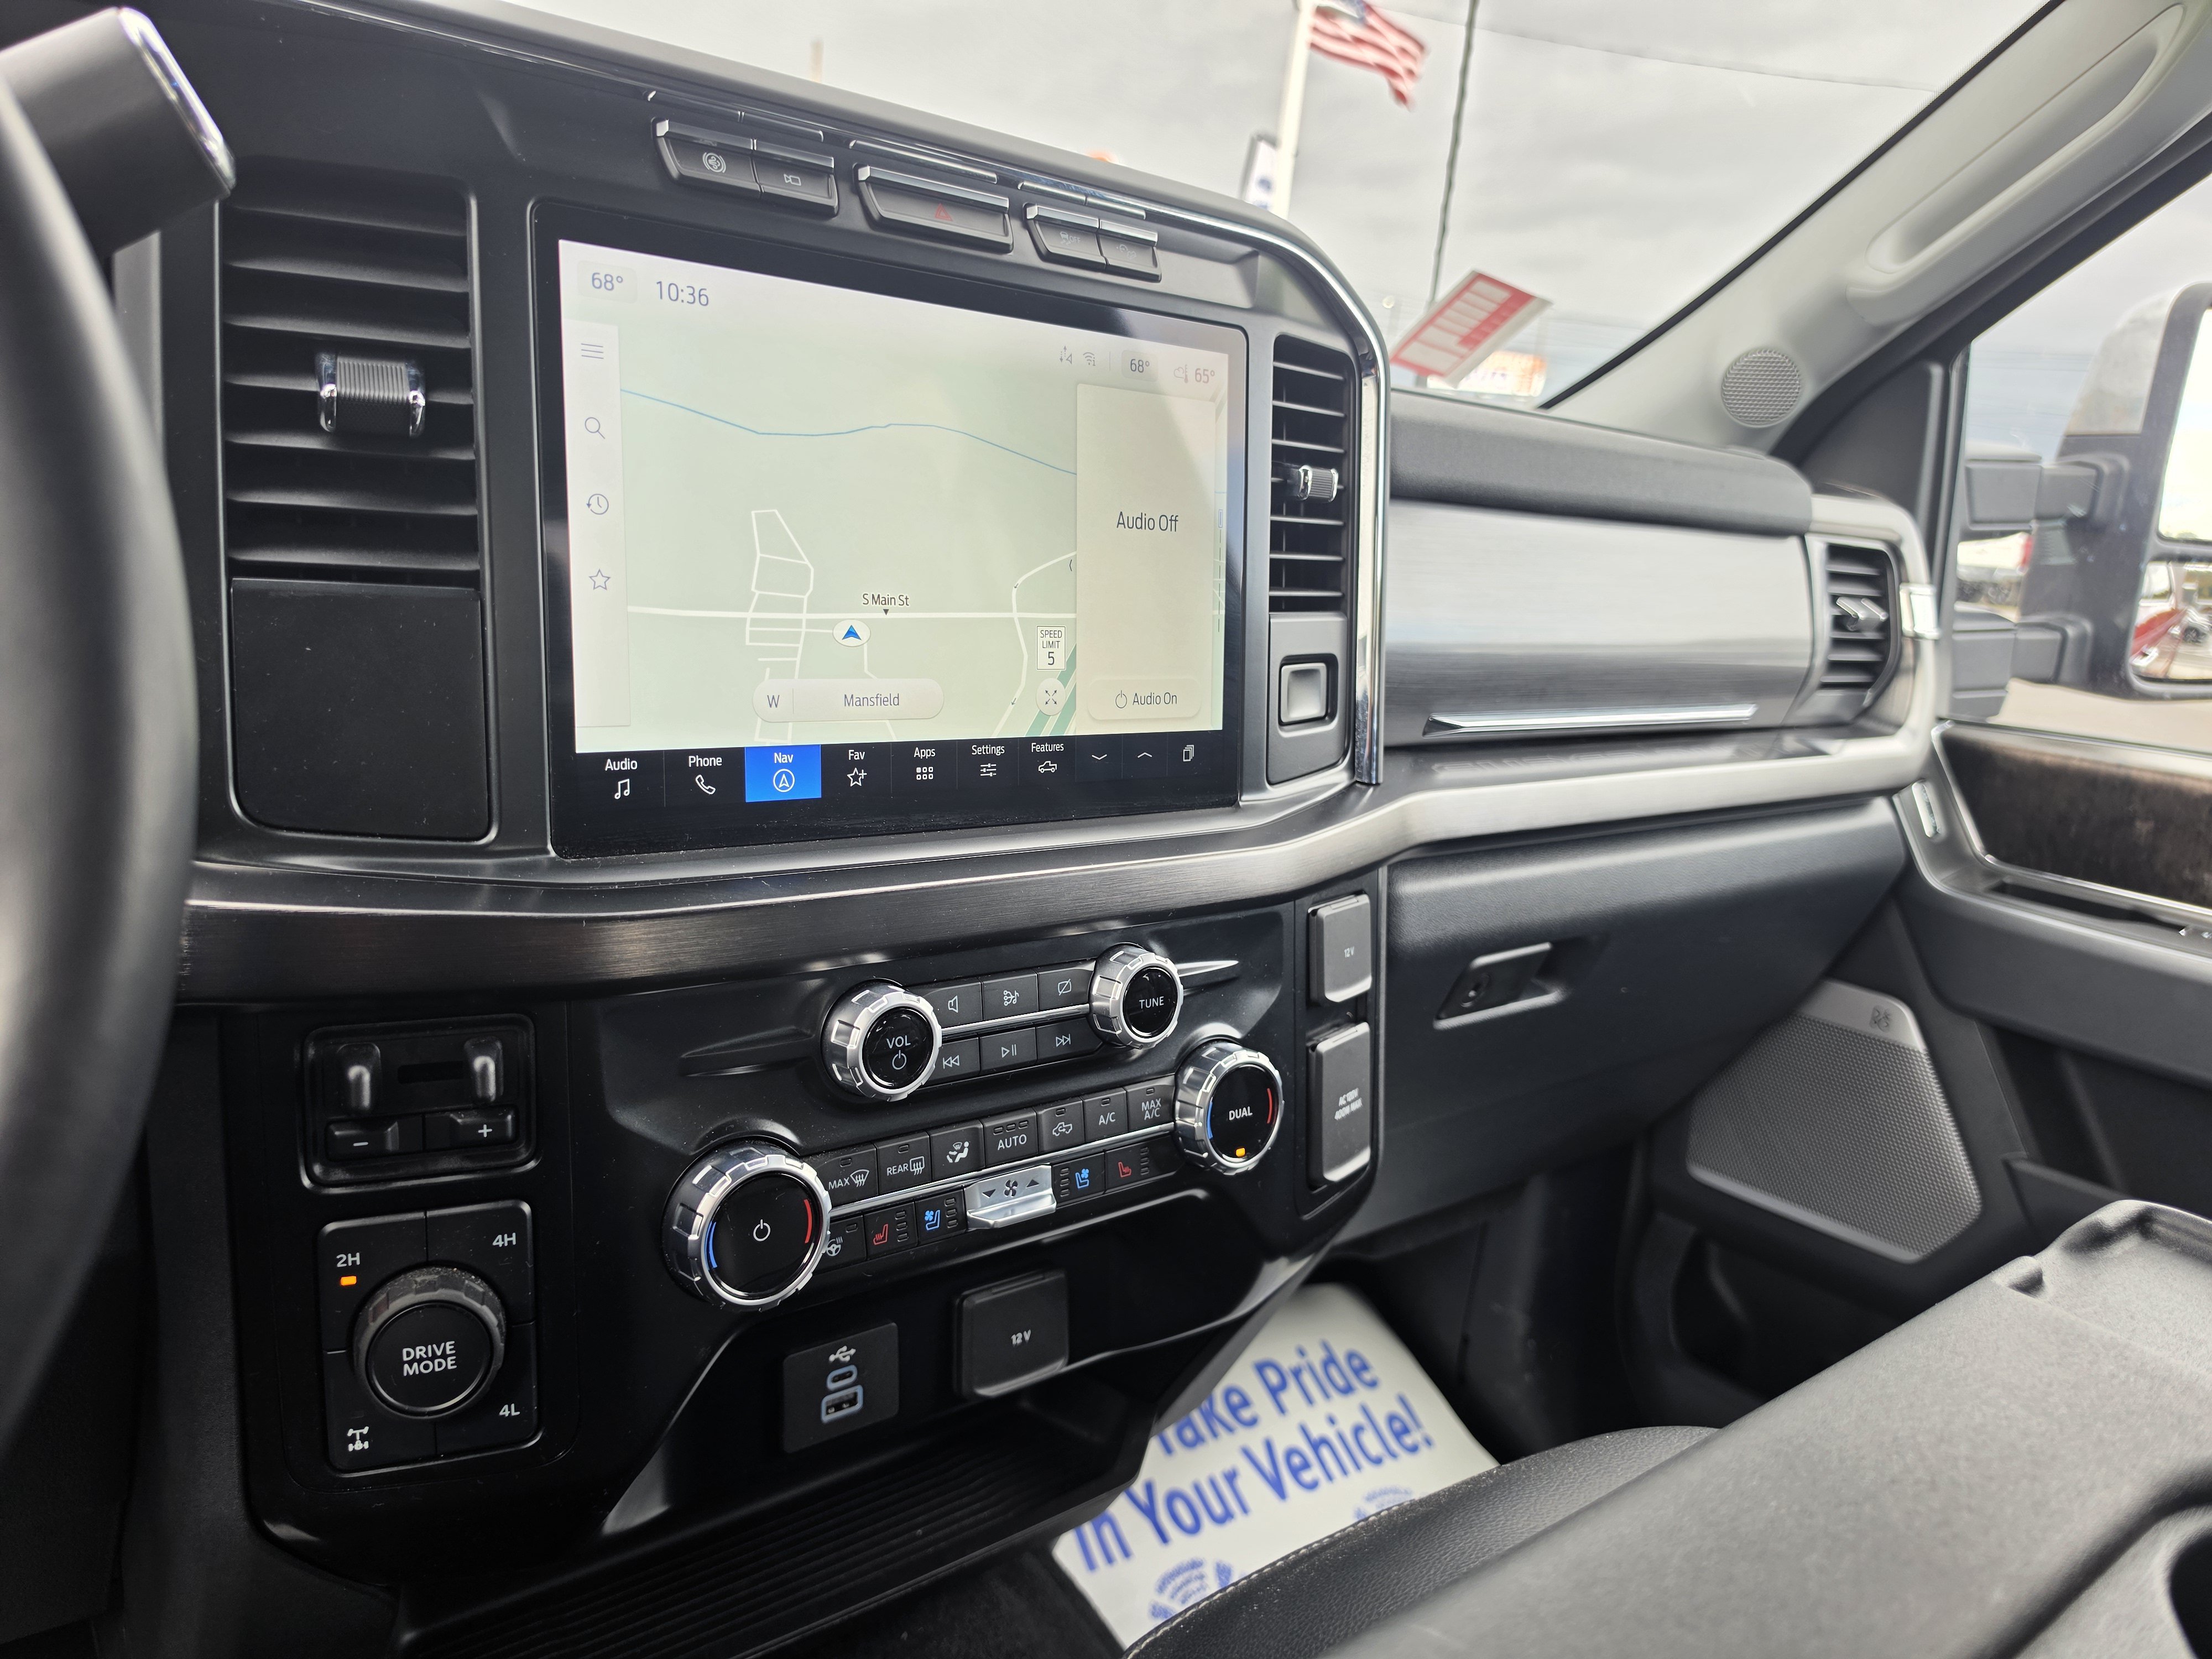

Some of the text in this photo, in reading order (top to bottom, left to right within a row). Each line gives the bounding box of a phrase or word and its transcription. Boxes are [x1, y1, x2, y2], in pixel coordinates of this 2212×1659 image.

[656, 280, 709, 306] 10:36
[1116, 511, 1179, 532] Audio Off
[862, 593, 910, 607] S Main St
[1040, 629, 1062, 638] SPEED
[1042, 640, 1061, 649] LIMIT
[1047, 651, 1055, 665] 5
[766, 693, 900, 708] W Mansfield
[1132, 692, 1177, 705] Audio On
[914, 747, 936, 759] Apps
[971, 744, 1005, 756] Settings
[1031, 742, 1065, 753] Features
[688, 754, 723, 768] Phone
[774, 752, 794, 764] Nav
[848, 749, 865, 761] Fav
[604, 757, 638, 771] Audio
[1139, 995, 1165, 1010] TUNE
[886, 1036, 911, 1050] VOL
[1141, 1097, 1162, 1112] MAX
[1098, 1112, 1116, 1126] A/C
[1144, 1107, 1161, 1121] A/C
[1228, 1105, 1253, 1121] DUAL
[997, 1133, 1027, 1151] AUTO
[886, 1162, 909, 1176] REAR
[828, 1176, 850, 1190] MAX
[492, 1232, 517, 1248] 4H
[336, 1252, 361, 1268] 2H
[402, 1340, 456, 1361] DRIVE
[403, 1356, 457, 1376] MODE
[1252, 1338, 1379, 1416] Pride
[499, 1403, 521, 1417] 4L
[1073, 1394, 1433, 1572] In Your Vehicle!
